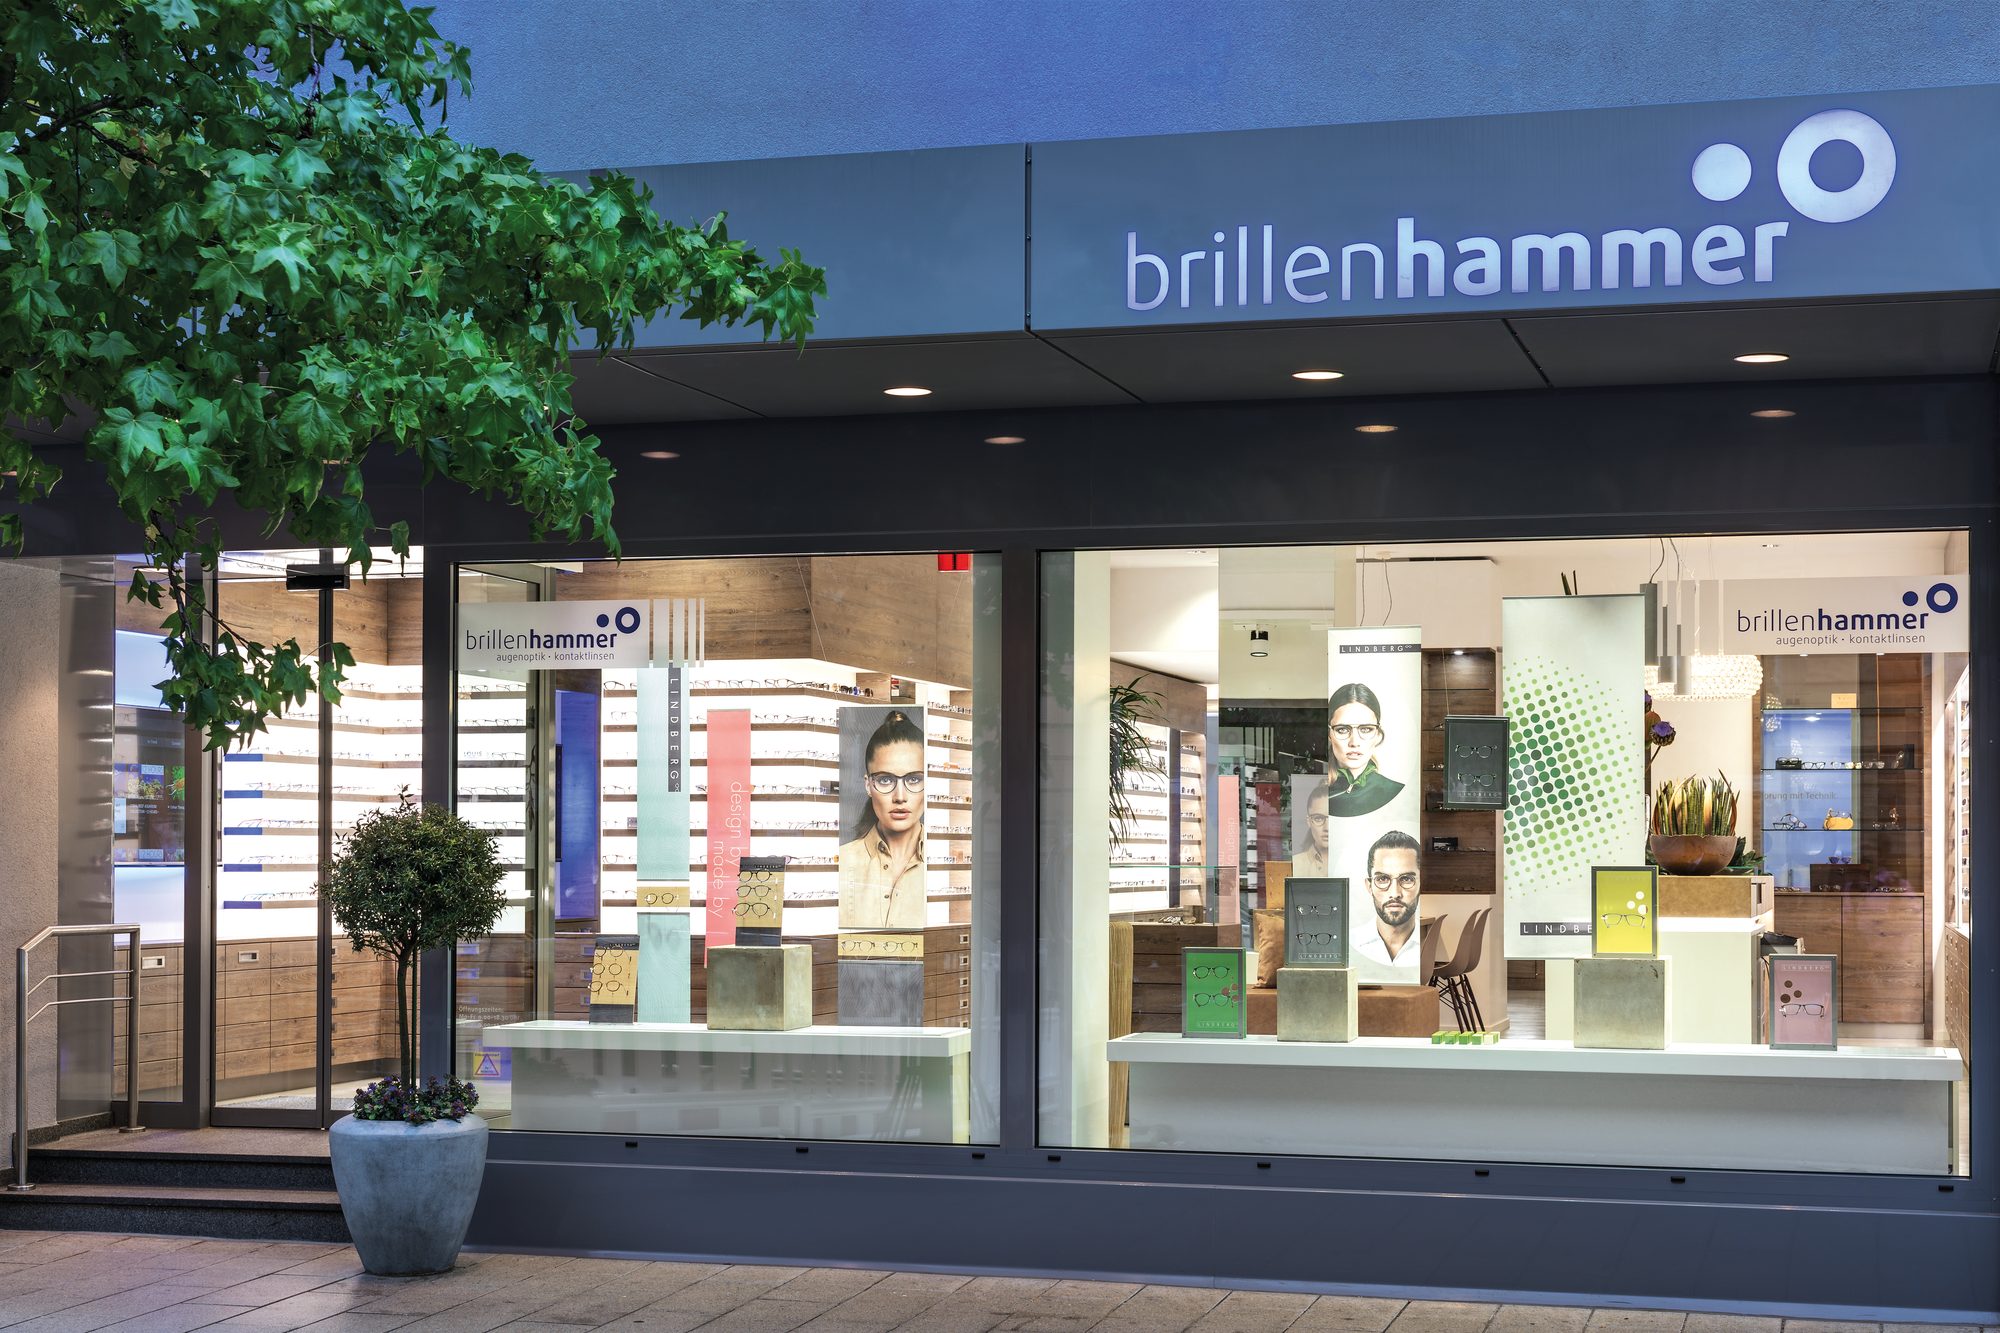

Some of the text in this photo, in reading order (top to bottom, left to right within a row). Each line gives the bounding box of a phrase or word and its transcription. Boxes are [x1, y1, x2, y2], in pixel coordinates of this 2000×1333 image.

[1127, 216, 1790, 312] brillenhammer
[1738, 608, 1929, 632] brillenhammer
[466, 629, 617, 650] brillenhammer
[1341, 645, 1404, 653] LINDBERG
[1776, 633, 1926, 647] augenoptik kontaktlinsen
[496, 651, 615, 663] augenoptik kontaktlinsen
[670, 678, 679, 780] LINDBERG
[725, 781, 749, 868] design by
[708, 841, 730, 918] made by
[1523, 924, 1592, 934] LINDBE
